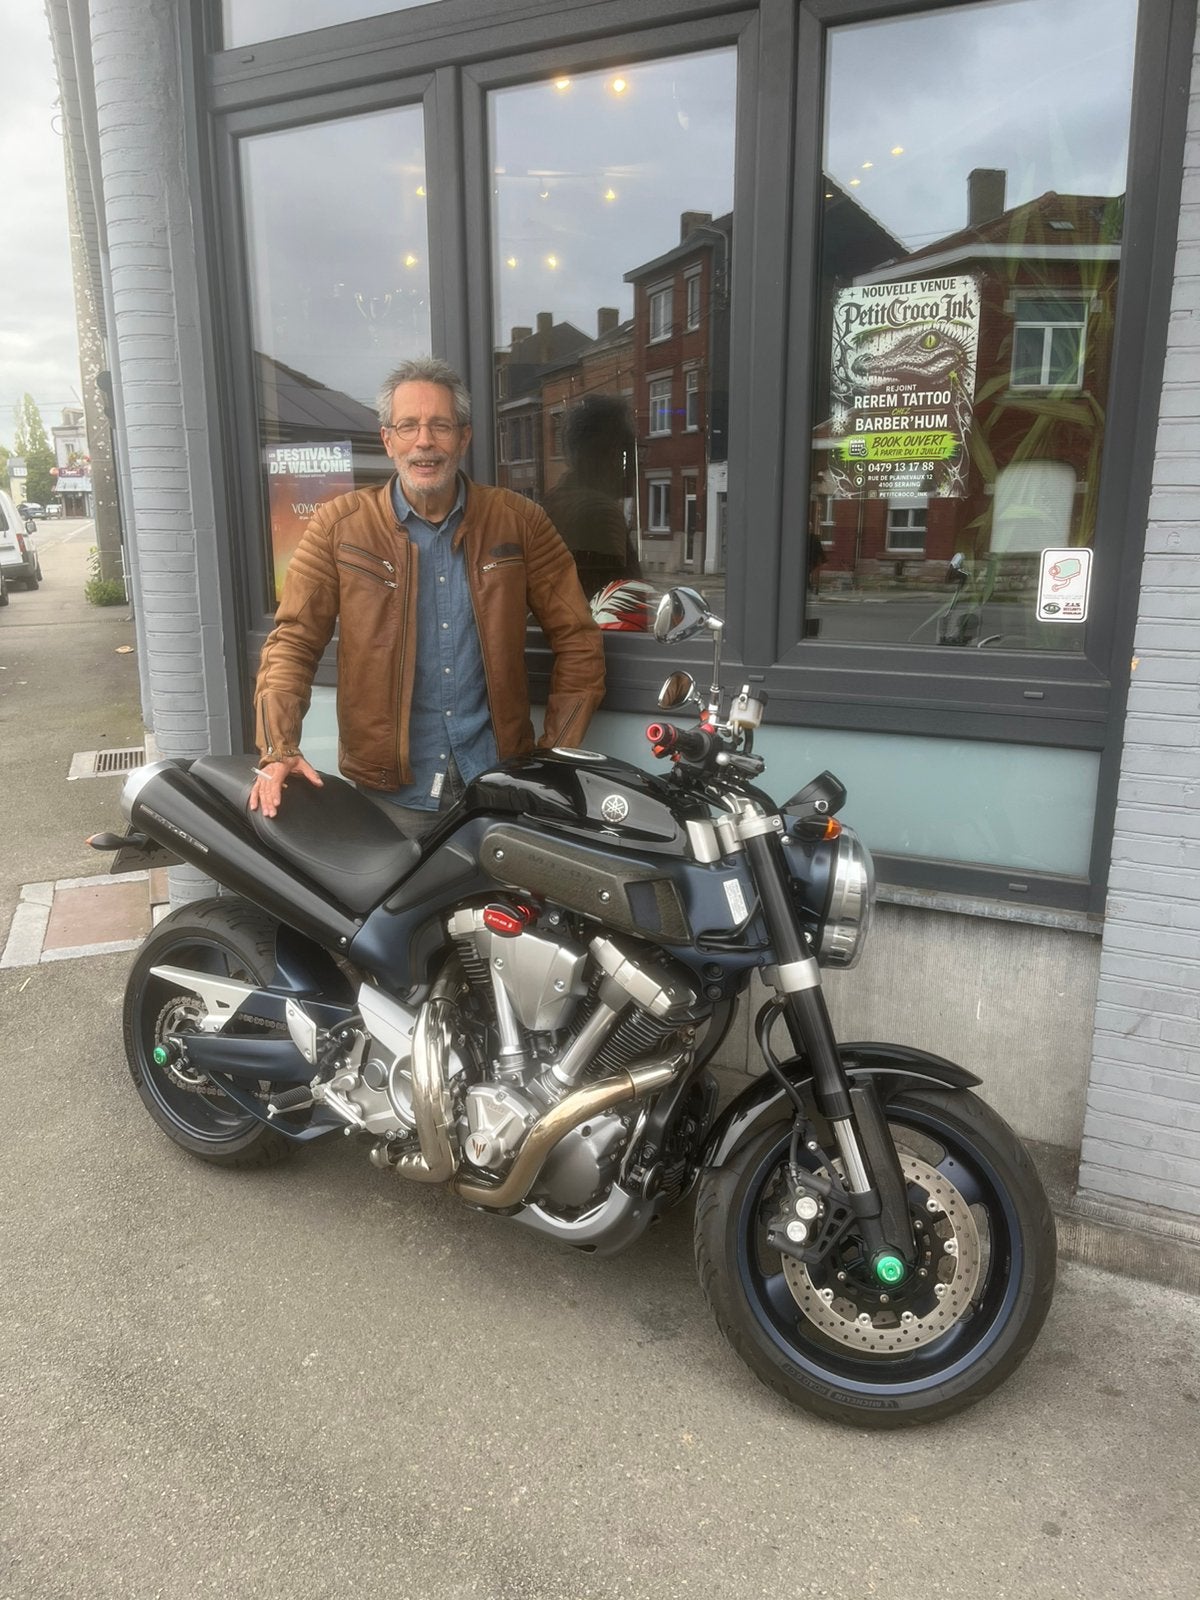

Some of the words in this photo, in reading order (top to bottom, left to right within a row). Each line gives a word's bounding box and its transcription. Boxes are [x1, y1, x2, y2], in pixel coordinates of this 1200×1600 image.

[862, 283, 917, 298] NOUVELLE
[920, 279, 957, 293] VENUE
[937, 293, 977, 323] Ink
[886, 384, 917, 393] REJOINT
[854, 393, 898, 409] REREM
[902, 390, 951, 407] TATTOO
[891, 407, 911, 416] CHEZ
[872, 436, 903, 449] BOOK
[903, 434, 948, 448] OUVERT
[276, 447, 342, 461] FESTIVALS
[880, 448, 902, 456] PARTIR
[904, 448, 914, 456] DU
[920, 447, 948, 455] JUILLET
[270, 461, 287, 474] DE
[288, 460, 351, 474] WALLONIE
[868, 462, 892, 472] 0479
[894, 462, 905, 472] 13
[908, 462, 920, 471] 17
[921, 461, 934, 471] 88
